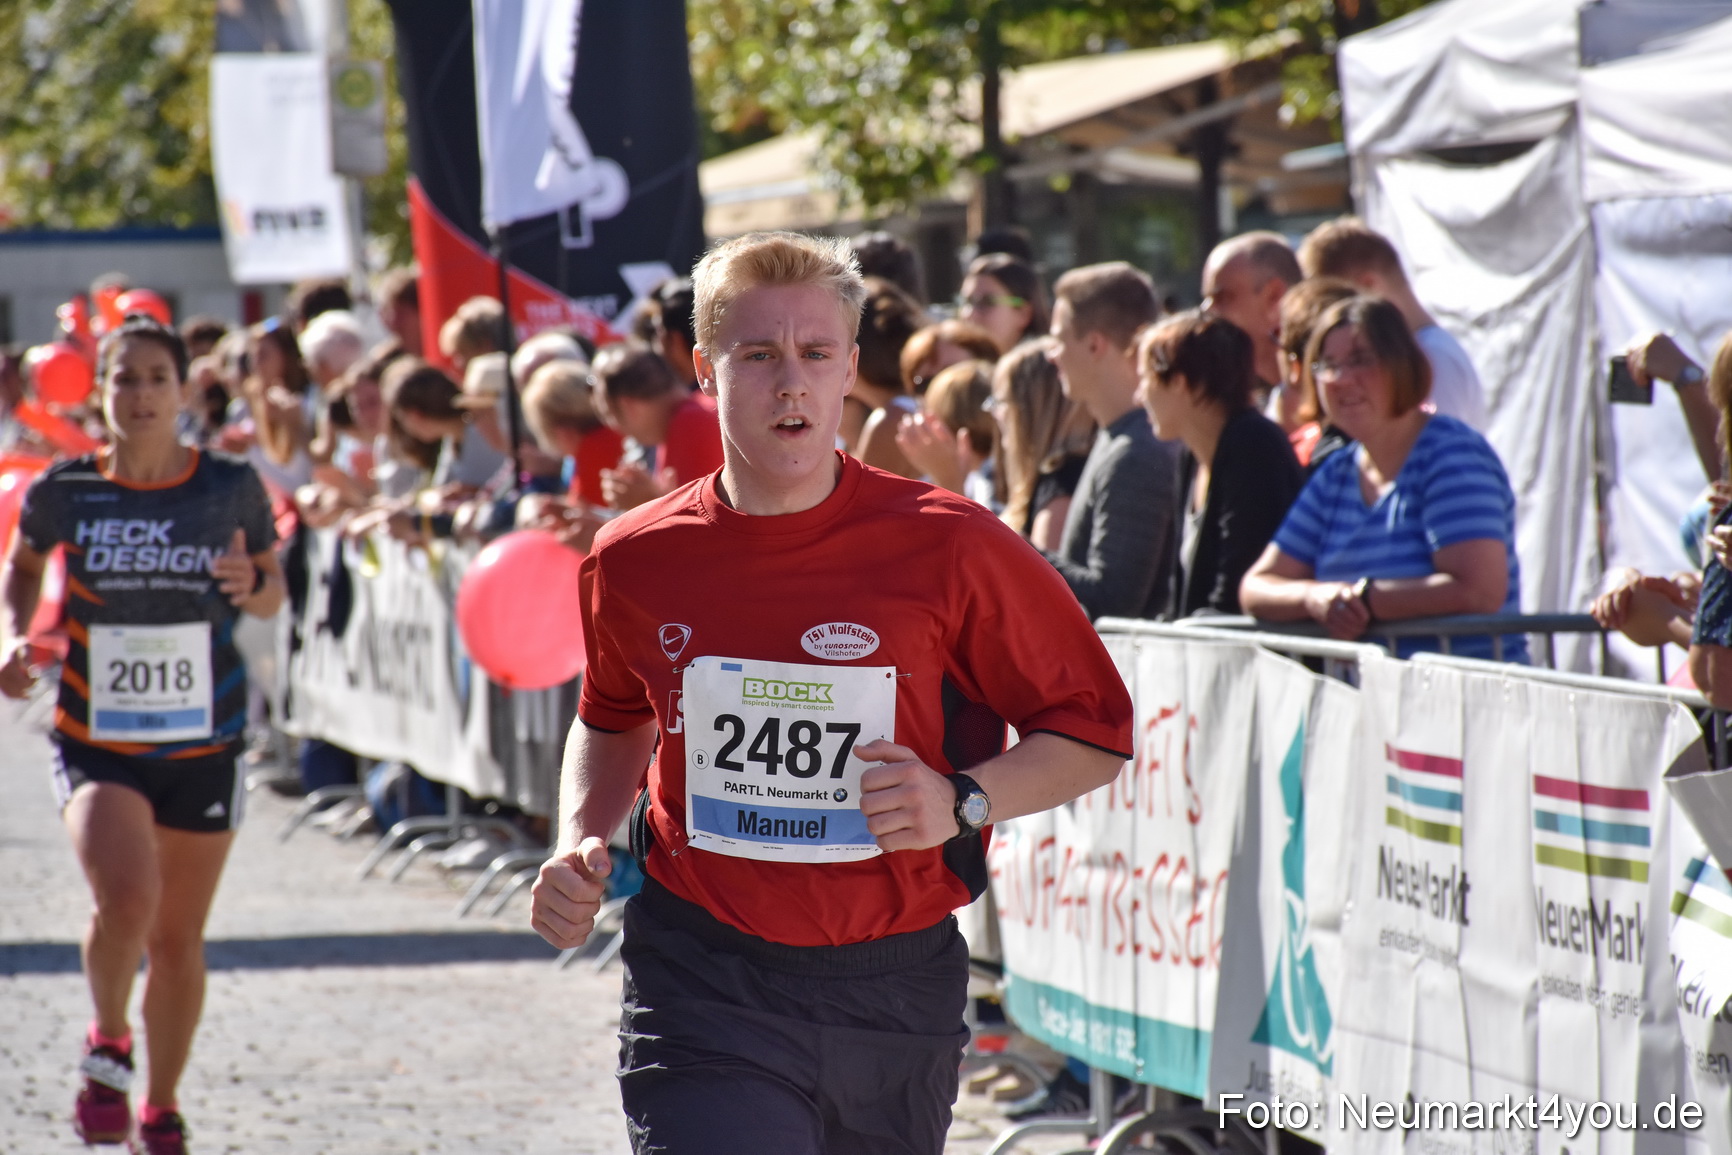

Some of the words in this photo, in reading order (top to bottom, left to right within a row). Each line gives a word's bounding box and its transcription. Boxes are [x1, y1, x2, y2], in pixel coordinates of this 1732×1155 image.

[75, 518, 175, 546] HECK
[84, 545, 225, 573] DESIGN
[806, 627, 825, 644] TSV
[828, 624, 875, 646] Wolfstein
[108, 658, 194, 694] 2018
[742, 677, 834, 704] BOCK
[742, 698, 770, 707] inspired
[771, 700, 780, 709] by
[781, 702, 802, 710] smart
[803, 703, 835, 712] concepts
[697, 753, 704, 765] B
[713, 713, 862, 779] 2487
[724, 781, 764, 797] PARTL
[767, 786, 829, 800] Neumarkt
[737, 809, 827, 840] Manuel
